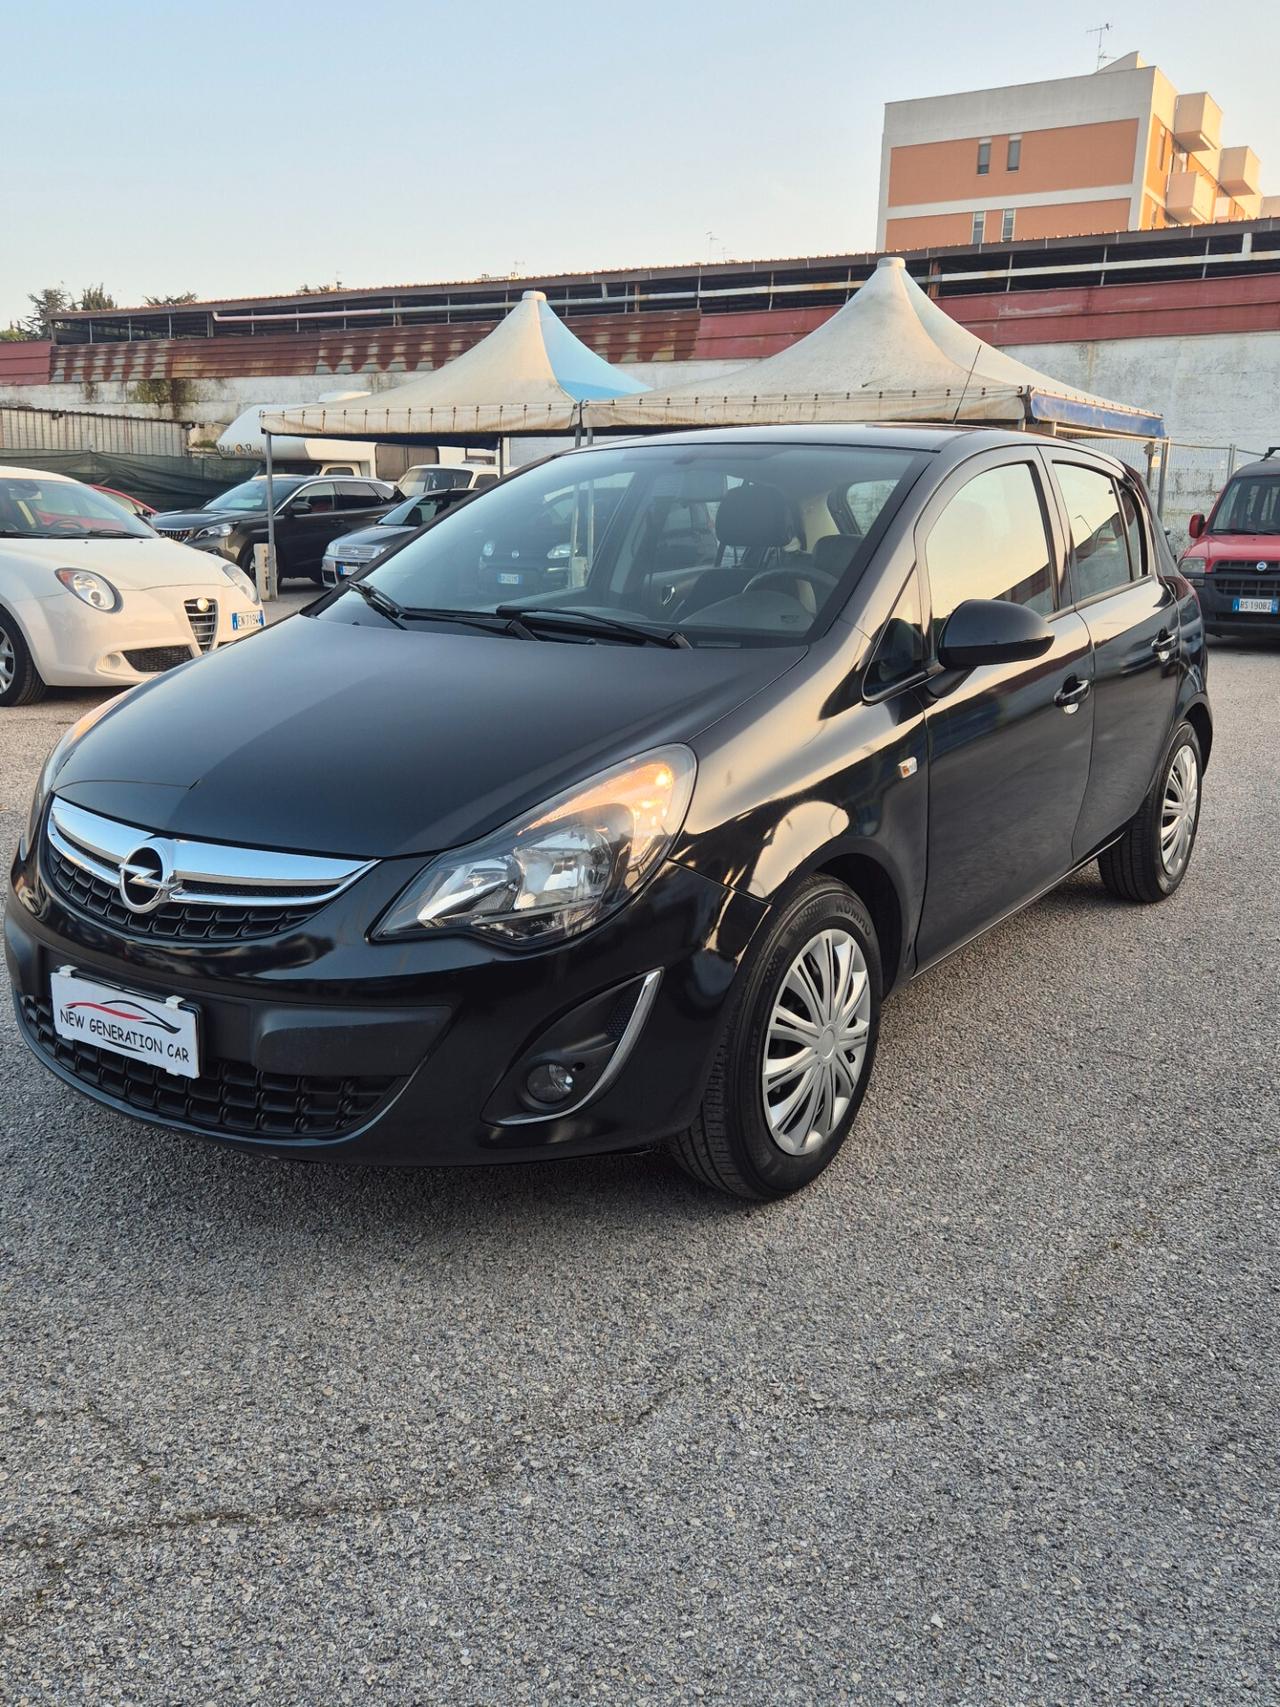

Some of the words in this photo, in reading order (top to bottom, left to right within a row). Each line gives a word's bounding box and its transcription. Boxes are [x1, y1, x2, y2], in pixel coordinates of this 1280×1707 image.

[59, 1009, 85, 1029] NEW
[89, 1018, 163, 1054] GENERATION
[166, 1043, 190, 1063] CAR
